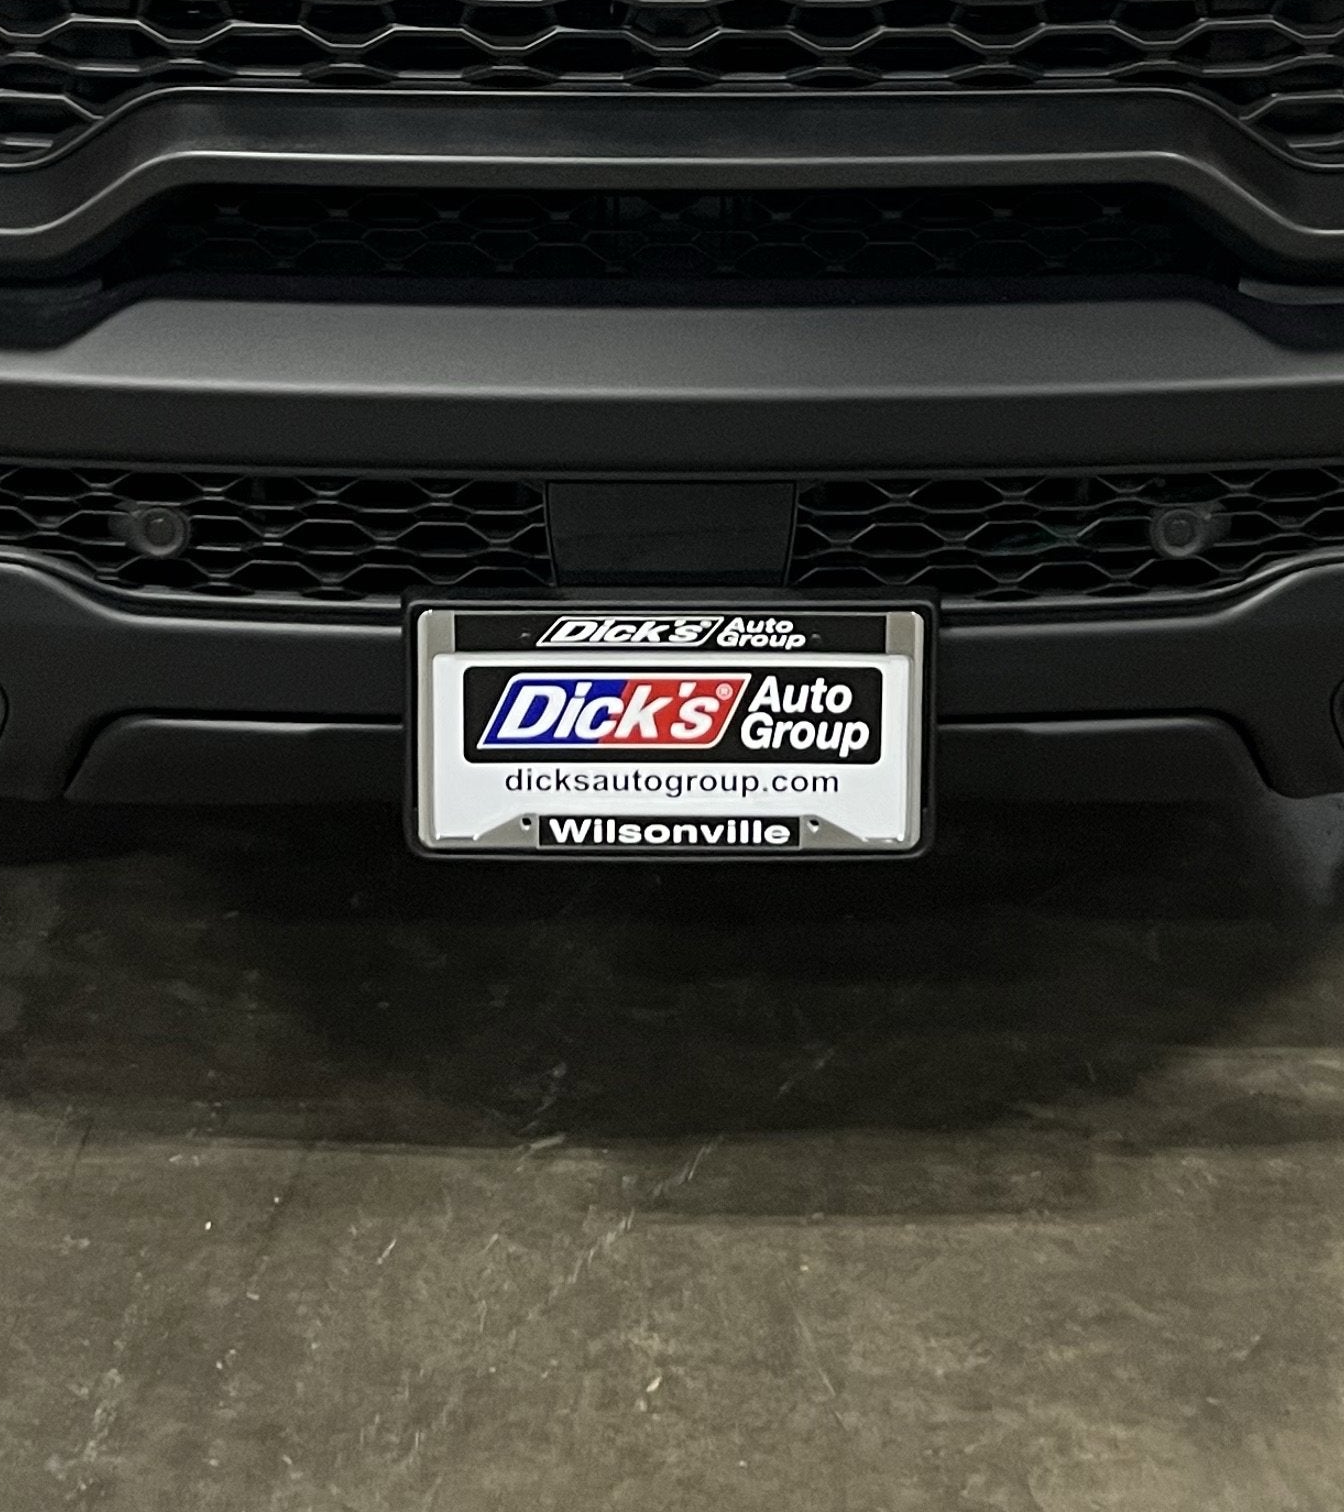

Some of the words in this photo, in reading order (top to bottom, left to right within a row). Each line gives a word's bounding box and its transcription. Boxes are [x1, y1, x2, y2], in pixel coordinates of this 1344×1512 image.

[550, 618, 703, 643] Dick's
[722, 617, 794, 634] Auto
[716, 632, 806, 650] Group
[747, 676, 853, 714] Auto
[496, 681, 720, 740] Dick's
[740, 714, 870, 758] Group
[505, 768, 839, 797] dicksautogroup.com
[549, 818, 791, 845] Wilsonville
